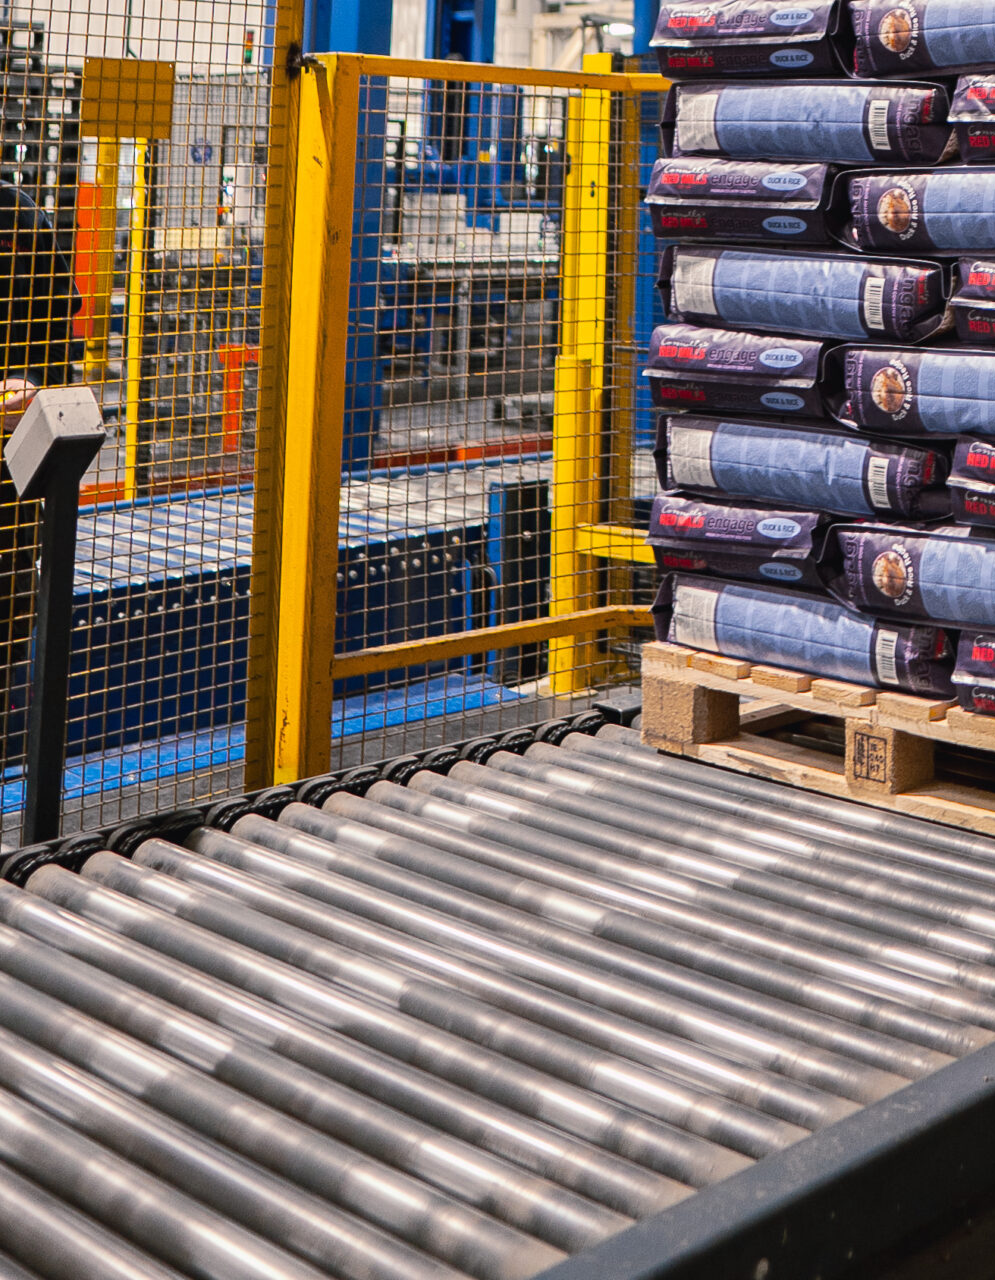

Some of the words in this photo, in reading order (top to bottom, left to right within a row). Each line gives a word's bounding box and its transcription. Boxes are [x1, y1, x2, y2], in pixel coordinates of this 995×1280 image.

[970, 136, 991, 147] RED
[711, 172, 759, 188] engage
[968, 273, 991, 286] RED
[968, 321, 991, 333] RED
[709, 347, 758, 364] engage
[967, 453, 989, 467] RED
[965, 501, 988, 514] RED
[707, 517, 756, 535] engage
[762, 524, 777, 533] DUCK
[783, 525, 796, 534] RICE
[972, 647, 995, 661] RED
